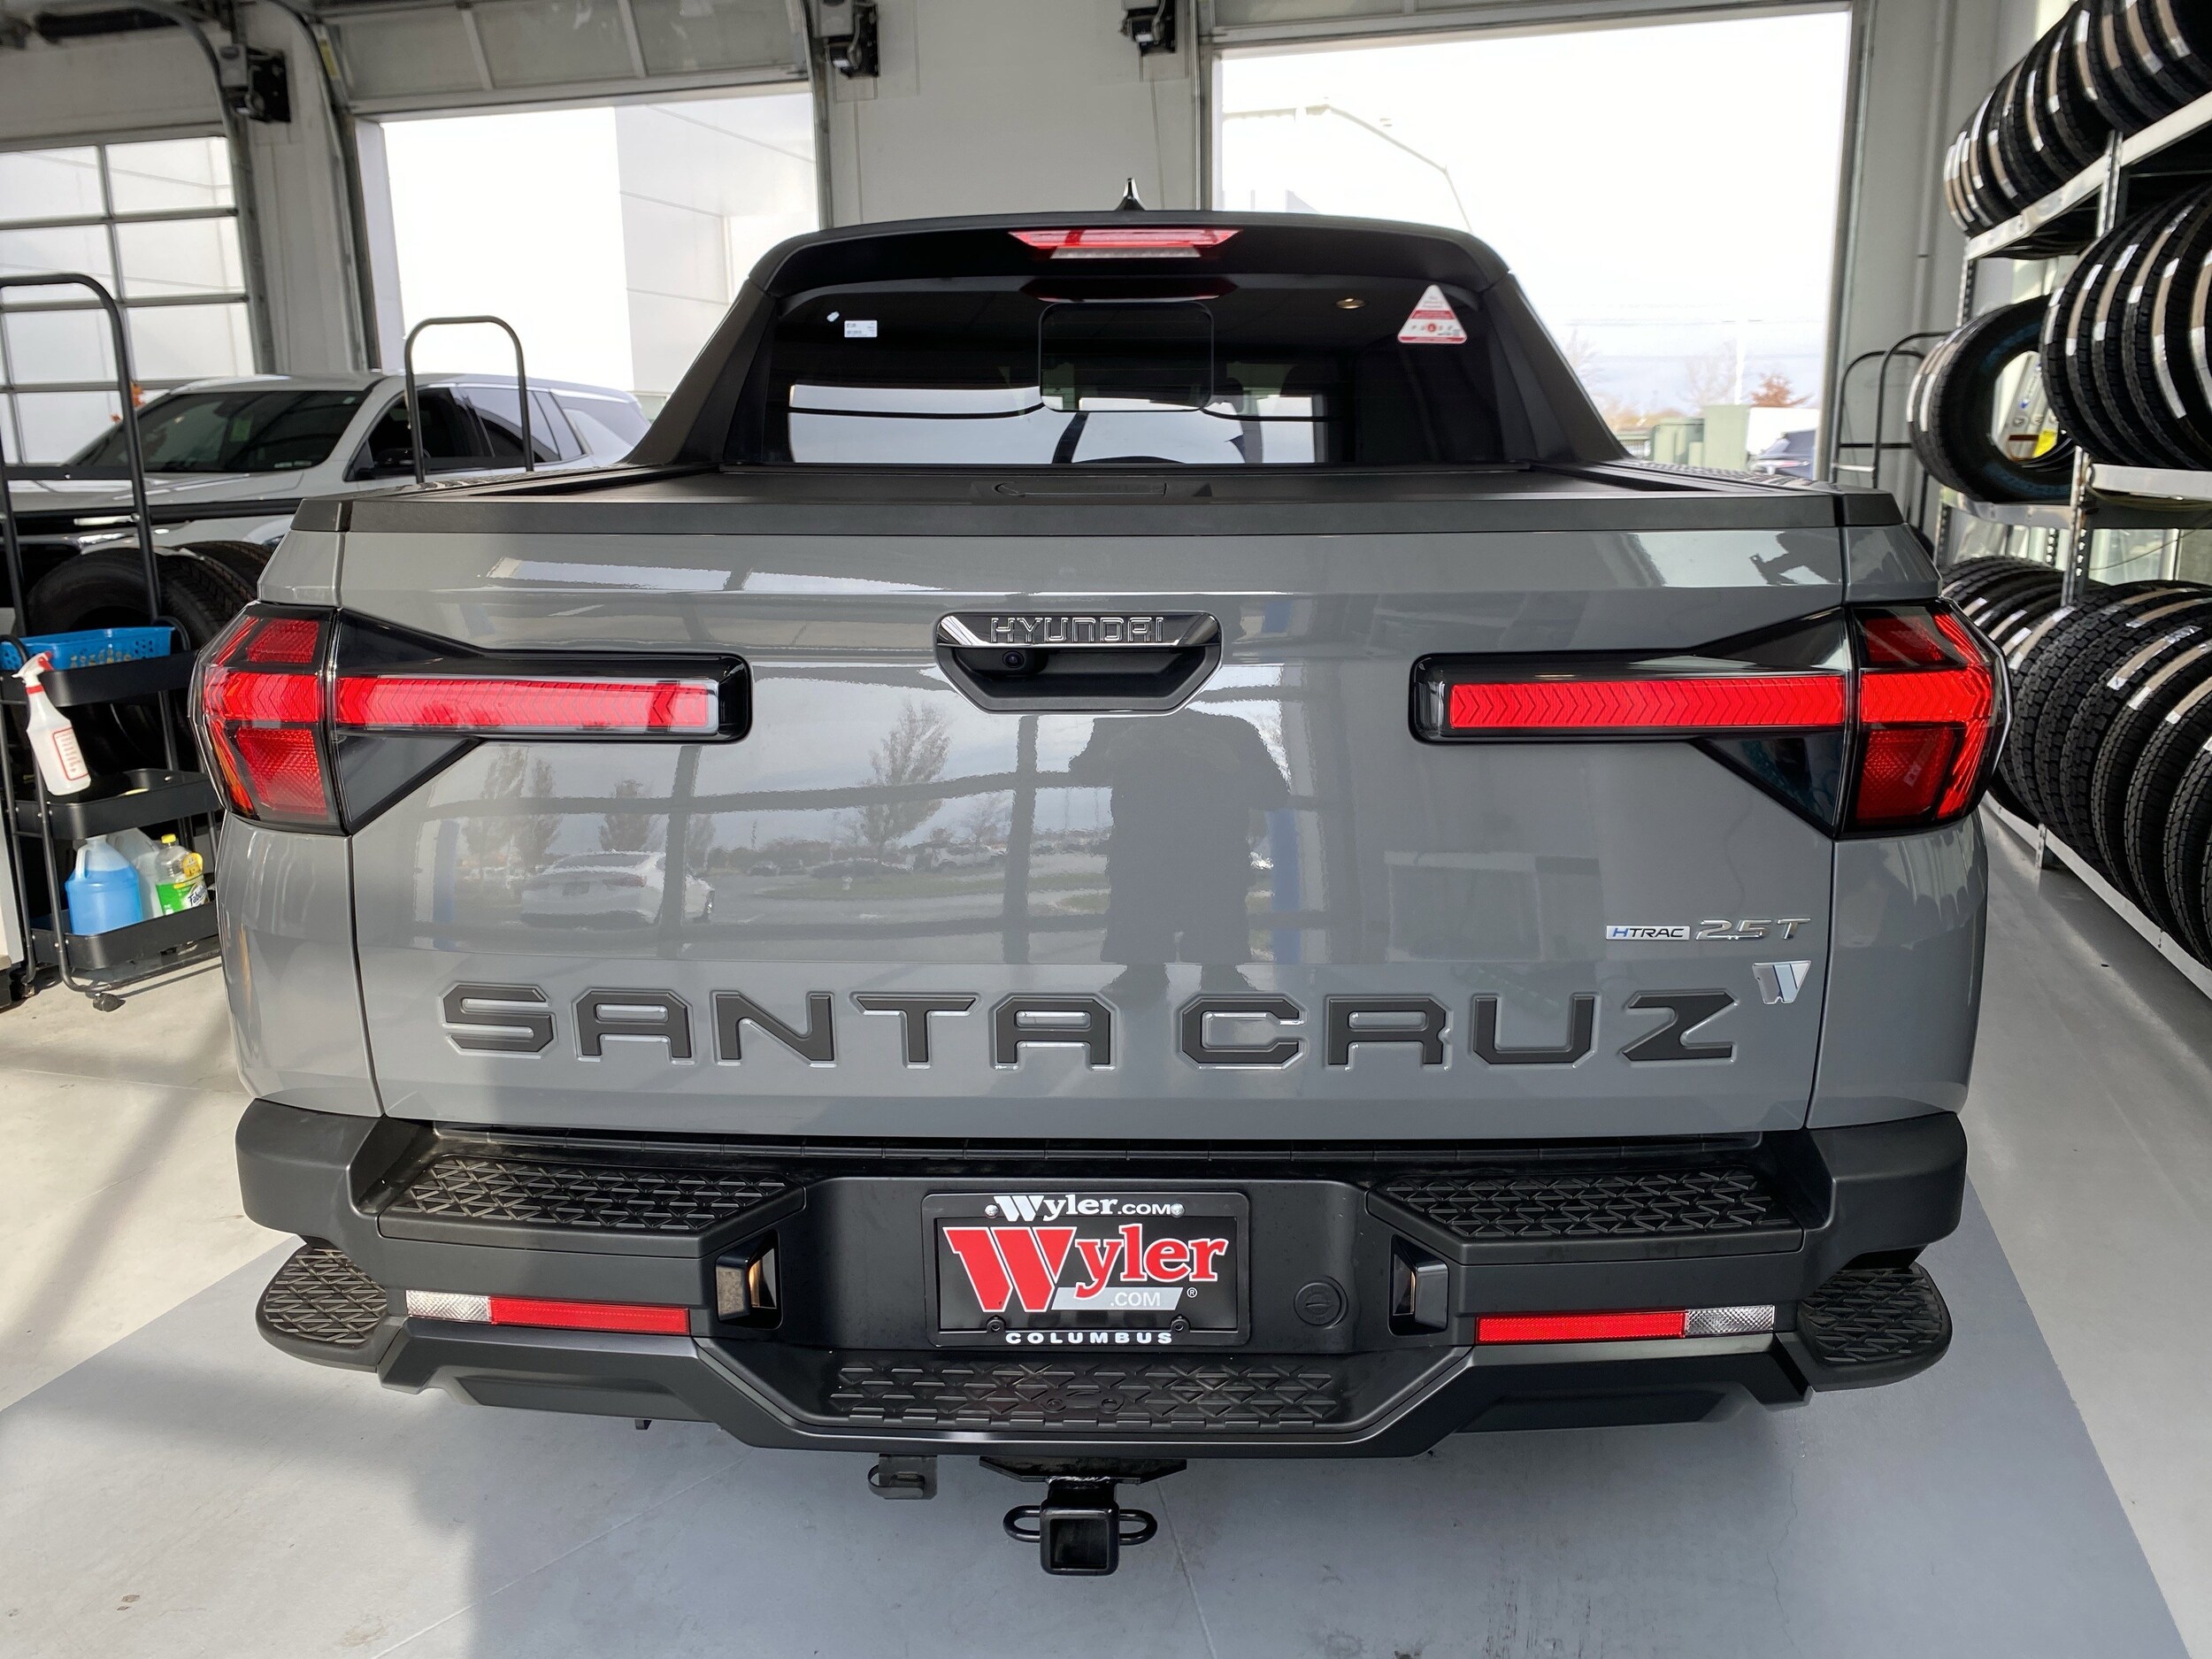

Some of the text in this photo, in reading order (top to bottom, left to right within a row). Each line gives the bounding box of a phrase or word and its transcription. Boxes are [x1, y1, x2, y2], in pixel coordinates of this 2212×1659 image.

[990, 617, 1164, 643] HYUNDAI
[1612, 927, 1685, 939] HTRAC
[442, 982, 1739, 1071] SANTA CRUZ
[942, 1224, 1229, 1313] Wyler
[1005, 1332, 1172, 1345] COLUMBUS
